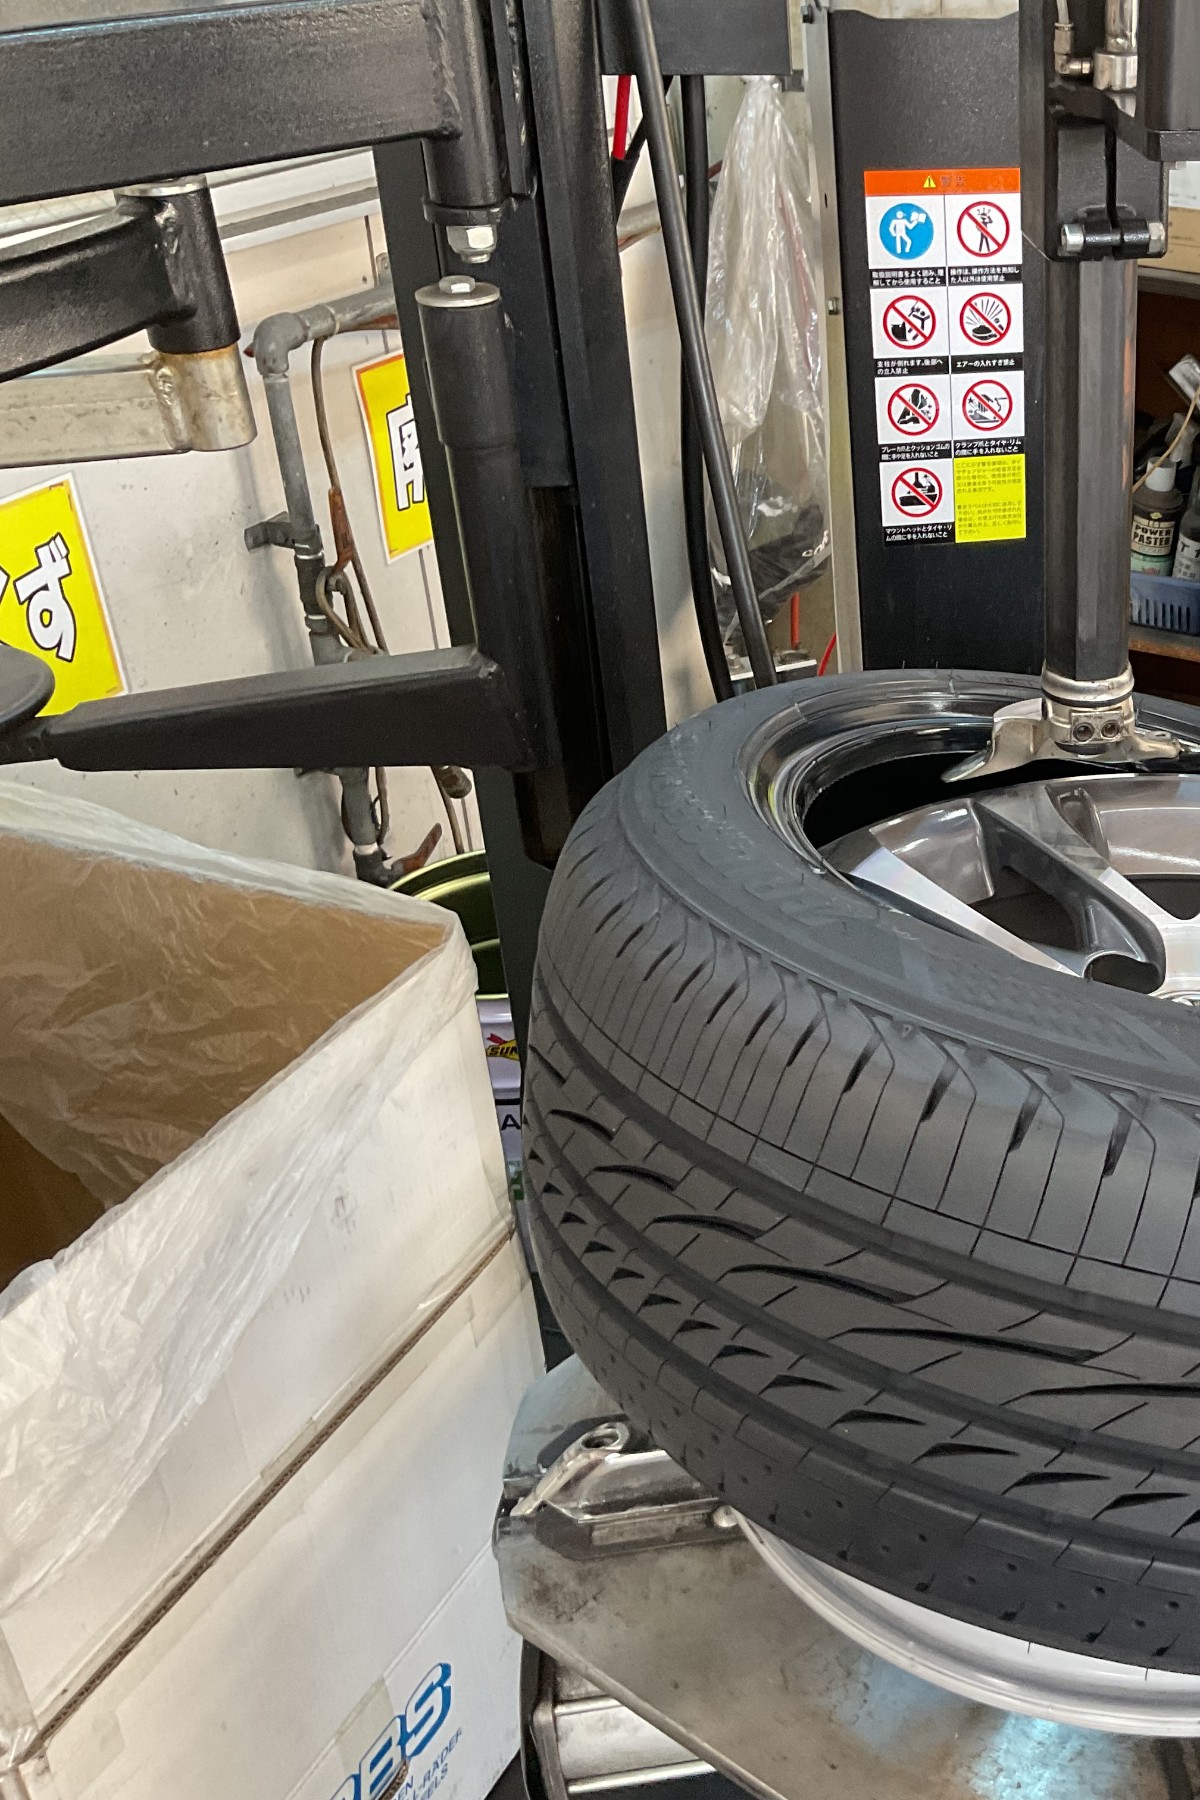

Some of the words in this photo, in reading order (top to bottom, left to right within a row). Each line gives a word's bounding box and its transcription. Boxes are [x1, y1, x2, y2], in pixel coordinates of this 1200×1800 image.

[1135, 524, 1171, 537] POWER
[1133, 531, 1171, 546] PASTER
[330, 1662, 452, 1800] BS
